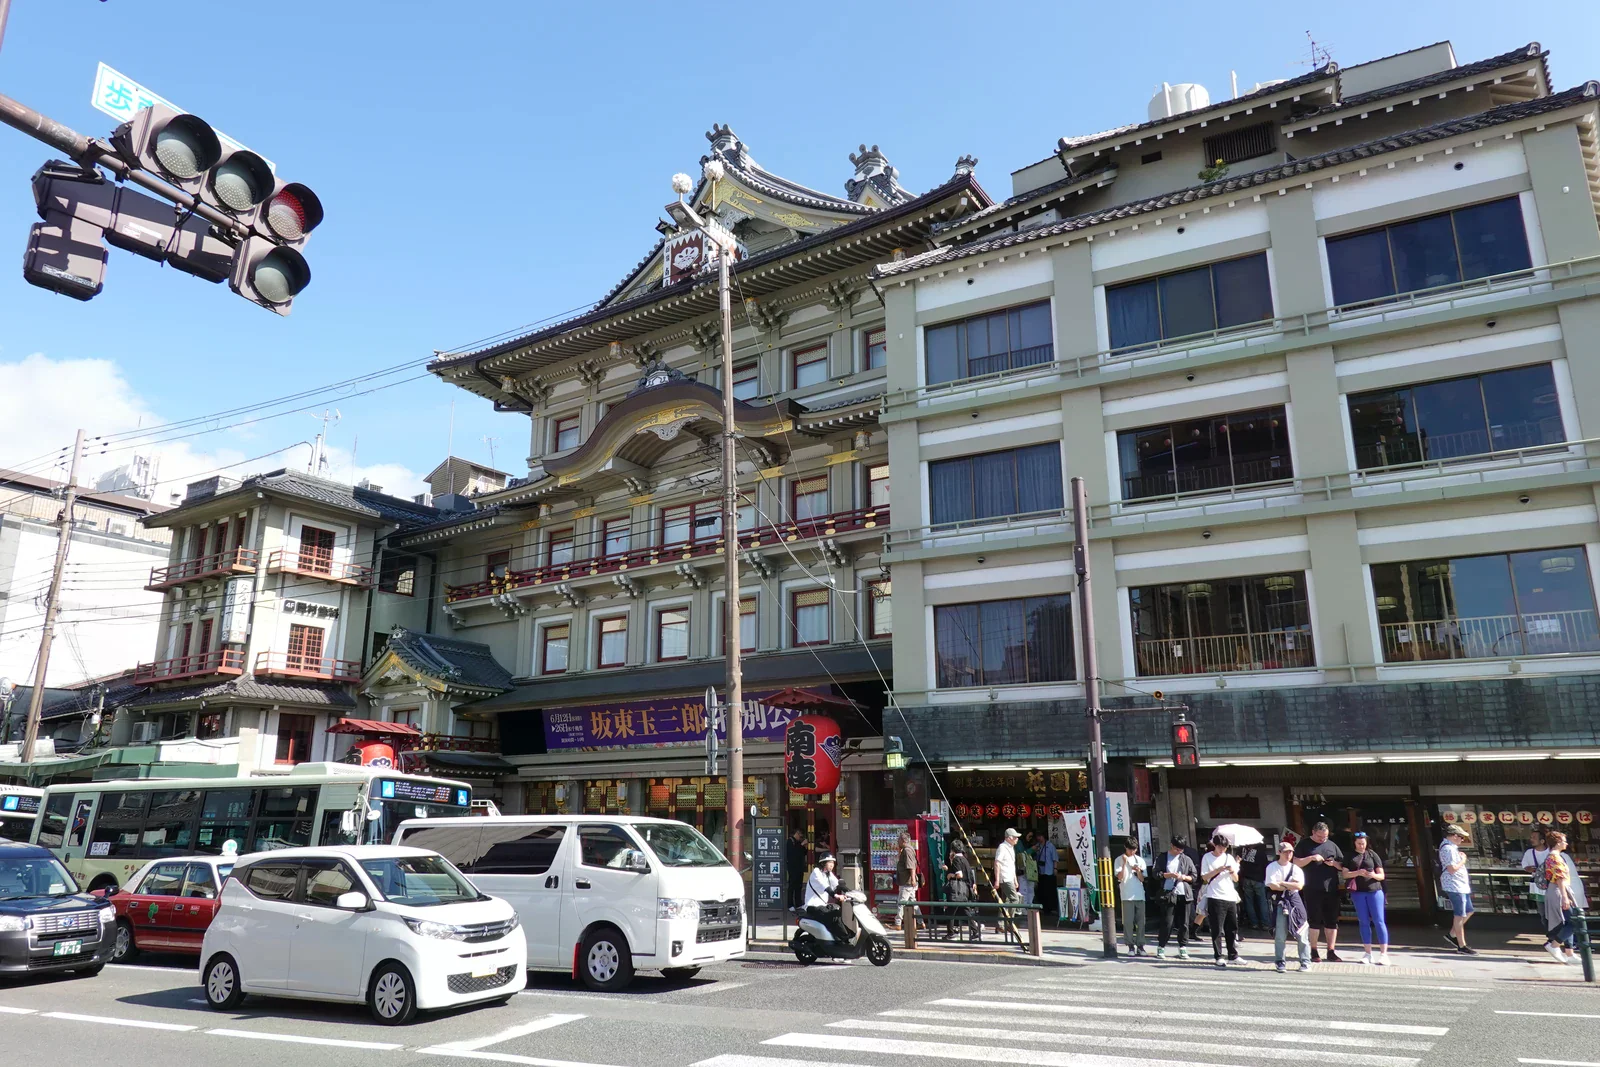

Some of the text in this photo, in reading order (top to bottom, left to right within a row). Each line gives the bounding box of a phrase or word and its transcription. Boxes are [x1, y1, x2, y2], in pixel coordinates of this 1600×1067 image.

[589, 703, 706, 740] 坂東玉三郎
[786, 720, 818, 789] 南座
[1442, 811, 1594, 825] 総本家にしんそば
